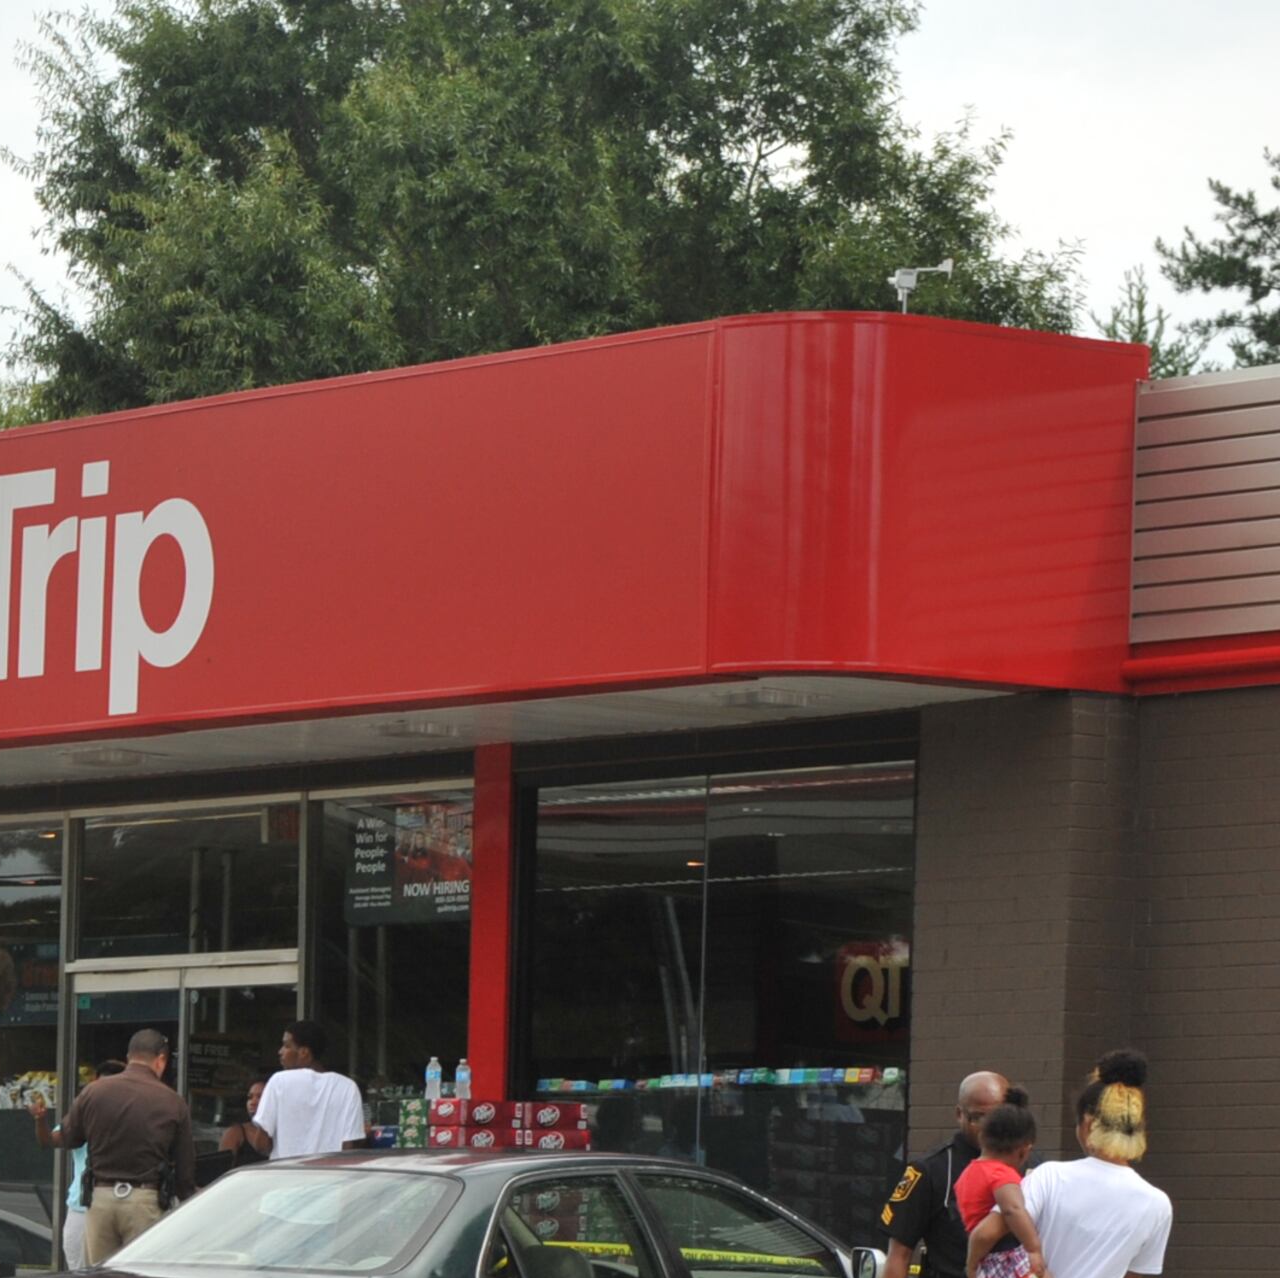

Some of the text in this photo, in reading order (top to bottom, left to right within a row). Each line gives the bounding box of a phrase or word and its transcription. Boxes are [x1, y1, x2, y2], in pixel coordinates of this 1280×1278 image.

[355, 861, 386, 875] People
[403, 880, 470, 897] NOW HIRING
[841, 954, 909, 1025] QT
